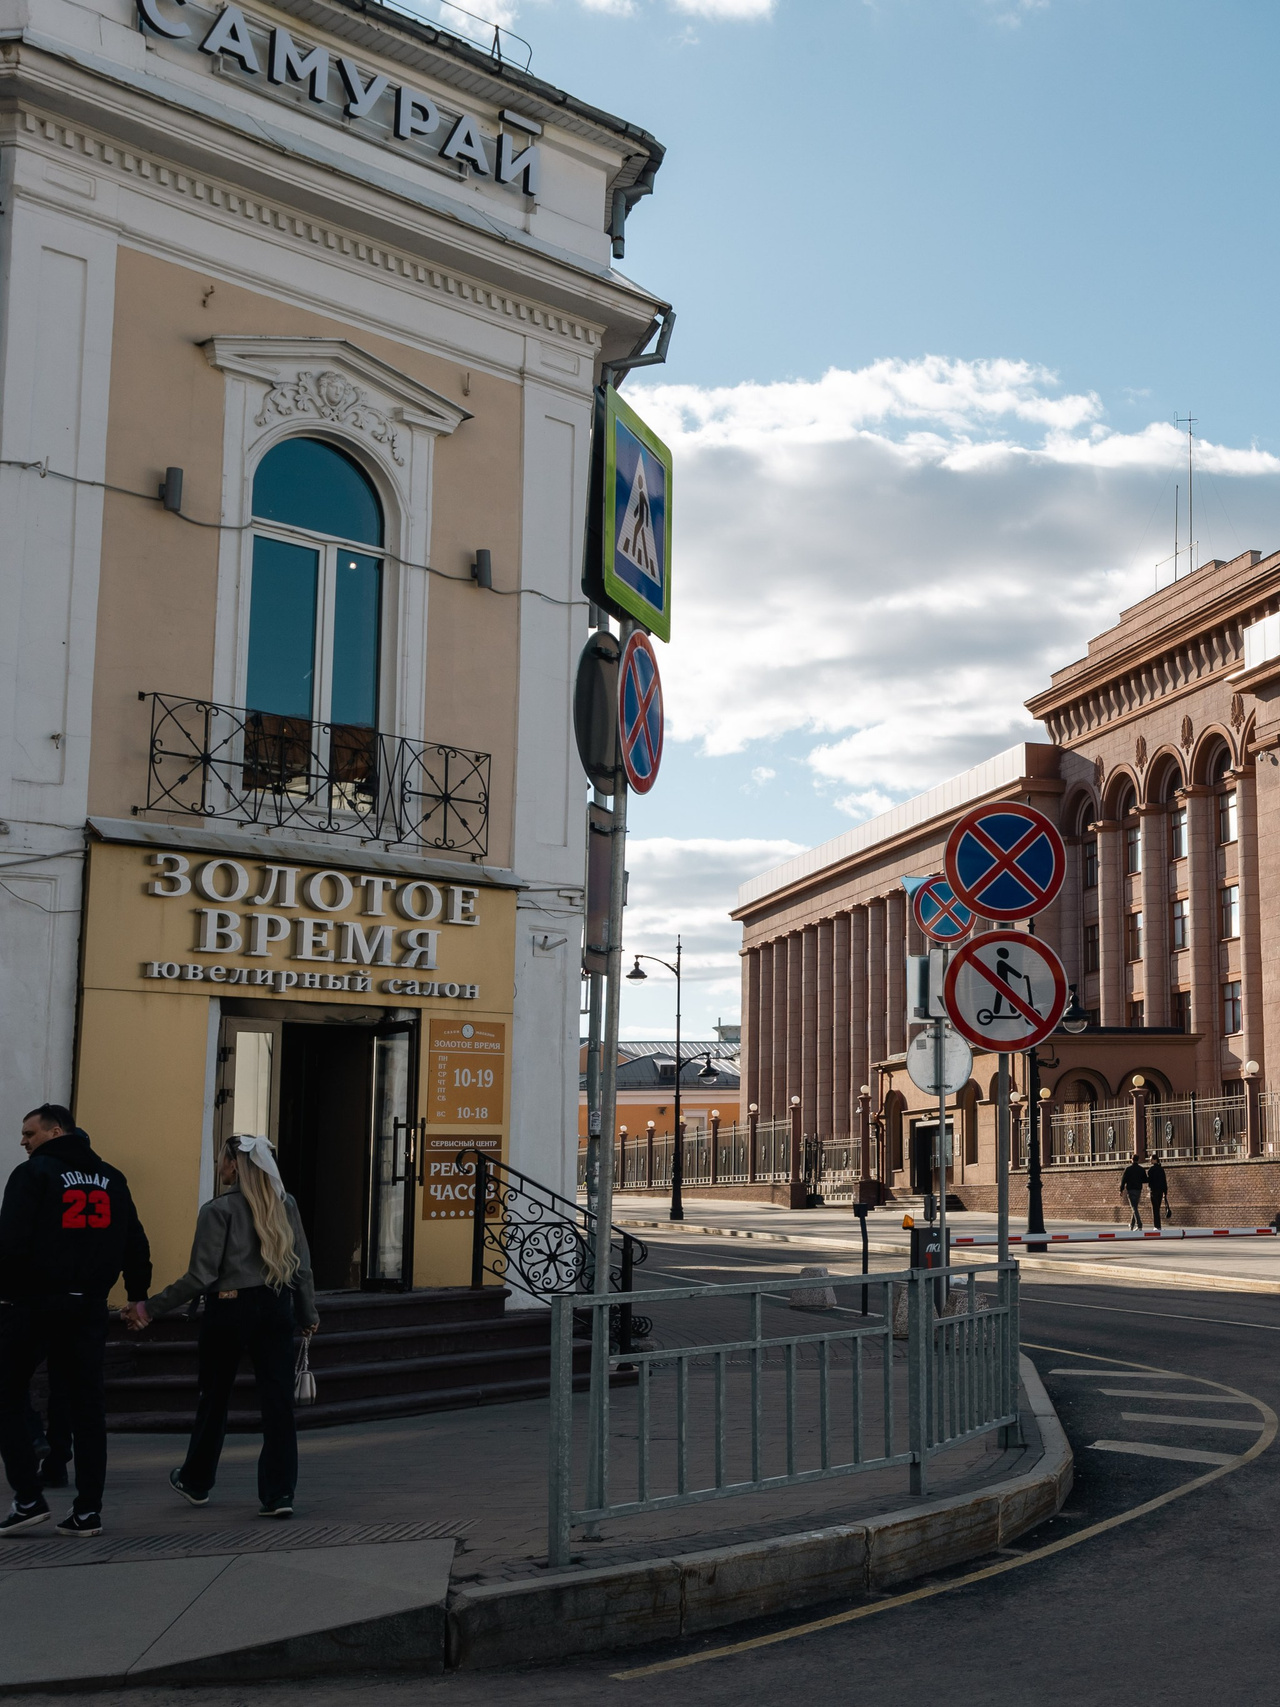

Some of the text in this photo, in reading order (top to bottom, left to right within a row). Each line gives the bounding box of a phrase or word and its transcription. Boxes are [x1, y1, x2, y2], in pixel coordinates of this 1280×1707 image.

[137, 0, 542, 196] САМУРАЙ
[148, 853, 481, 927] ЗОЛОТОЕ
[194, 907, 442, 970] ВРЕМЯ
[144, 960, 481, 999] ювелирный салон
[434, 1039, 501, 1050] ЗОЛОТОЕ ВРЕМЯ
[453, 1068, 494, 1088] 10-19
[457, 1106, 489, 1119] 10-18
[430, 1139, 475, 1147] СЕРВИСНЫЙ
[430, 1162, 497, 1176] РЕМОТ
[61, 1171, 110, 1190] JORDAN
[62, 1189, 111, 1229] 23
